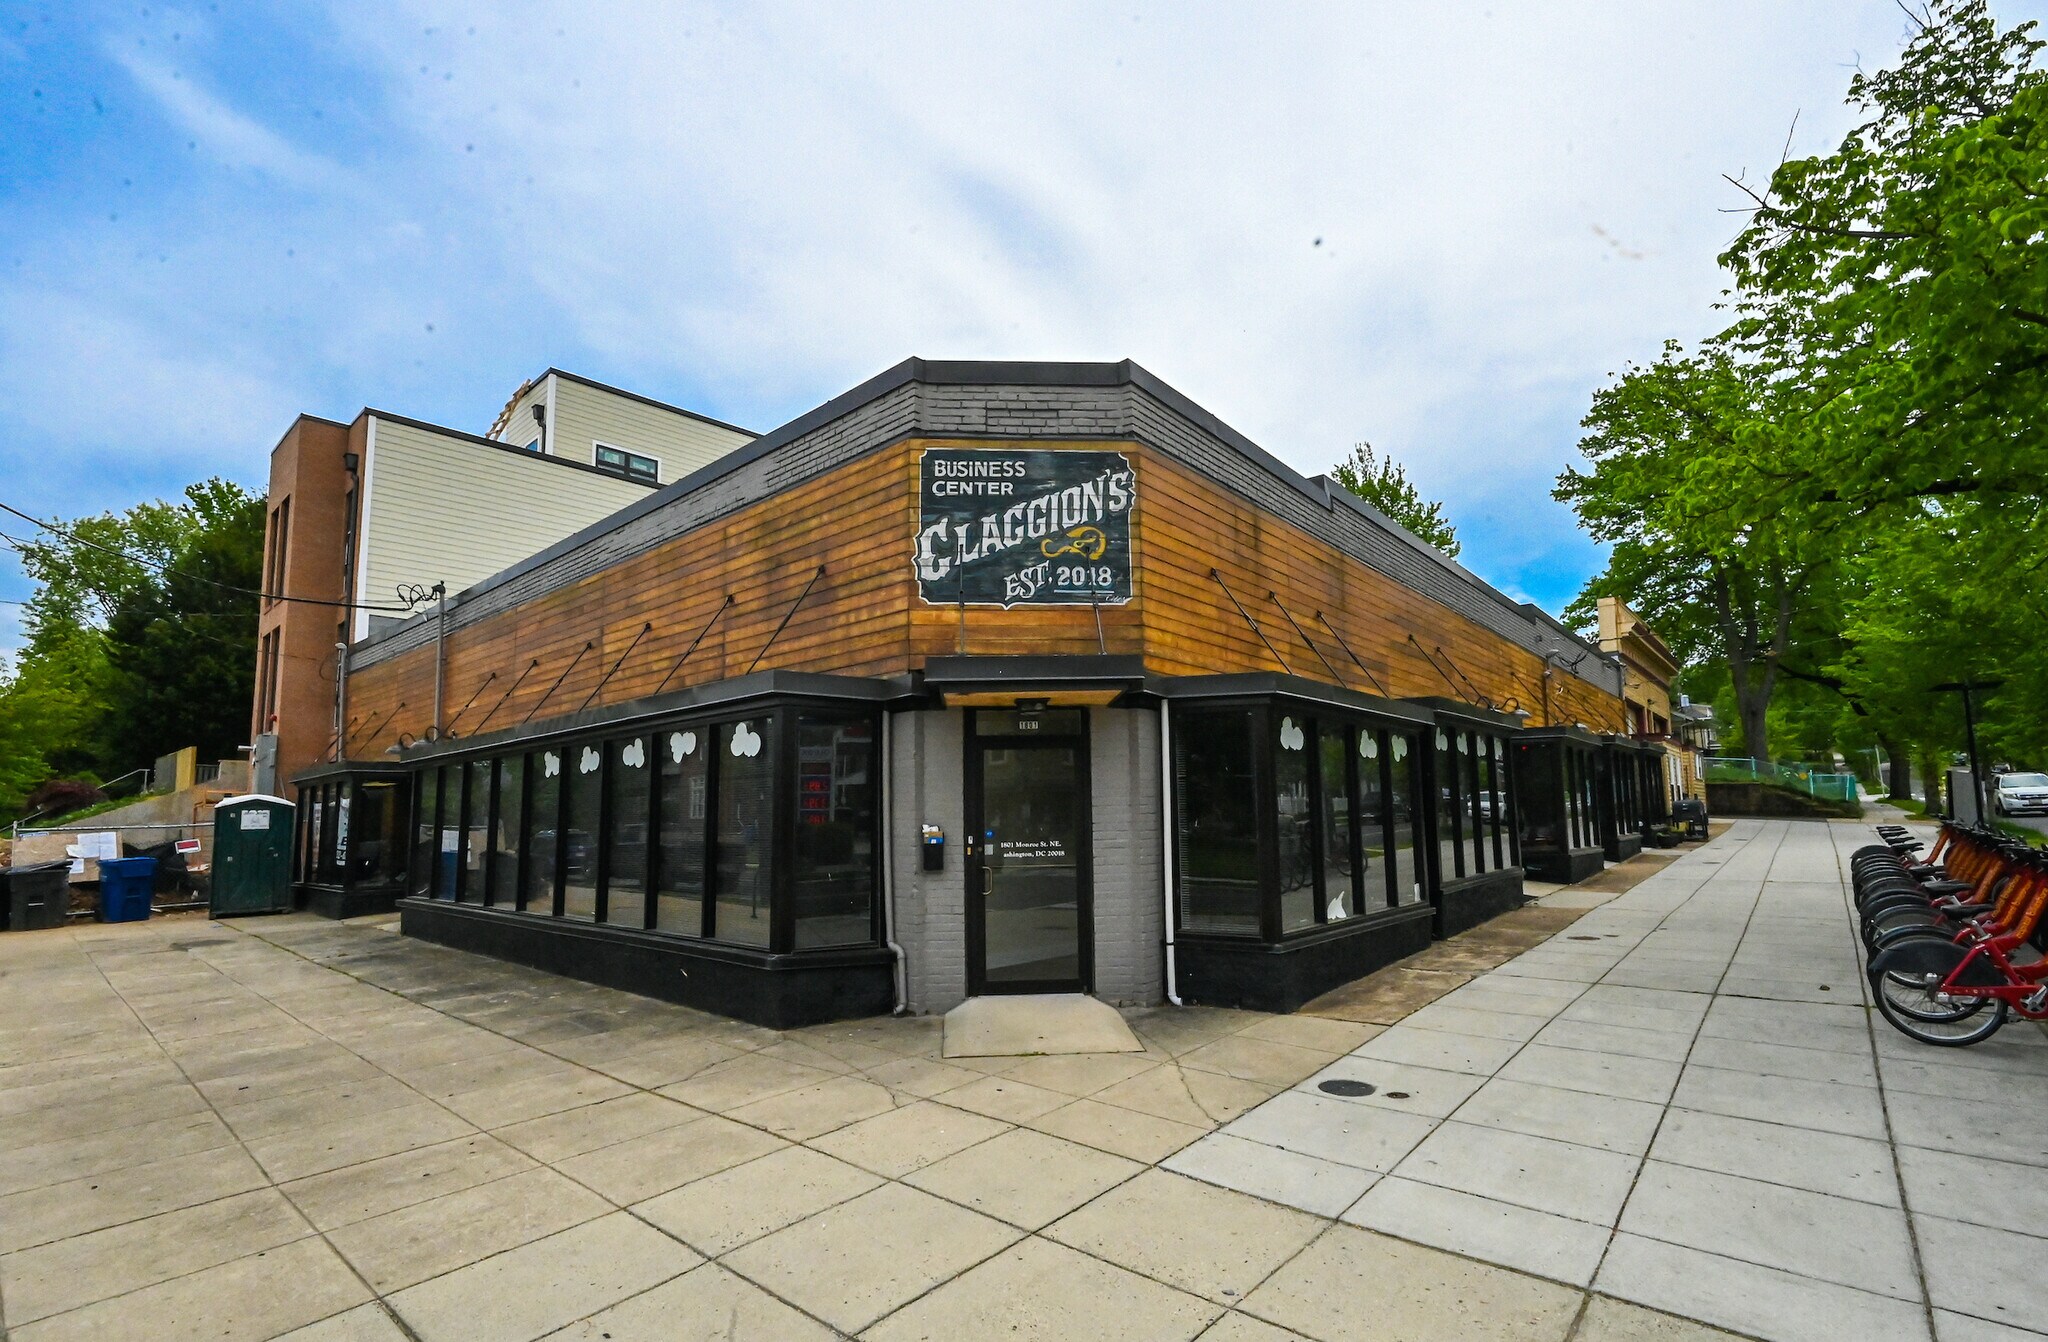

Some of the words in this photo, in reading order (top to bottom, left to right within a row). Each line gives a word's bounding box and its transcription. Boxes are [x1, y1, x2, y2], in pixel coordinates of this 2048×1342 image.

[934, 460, 1026, 478] BUSINESS
[931, 480, 1014, 497] CENTER
[1004, 560, 1053, 601] EST.
[1057, 565, 1113, 587] 2018
[1040, 840, 1049, 848] St.
